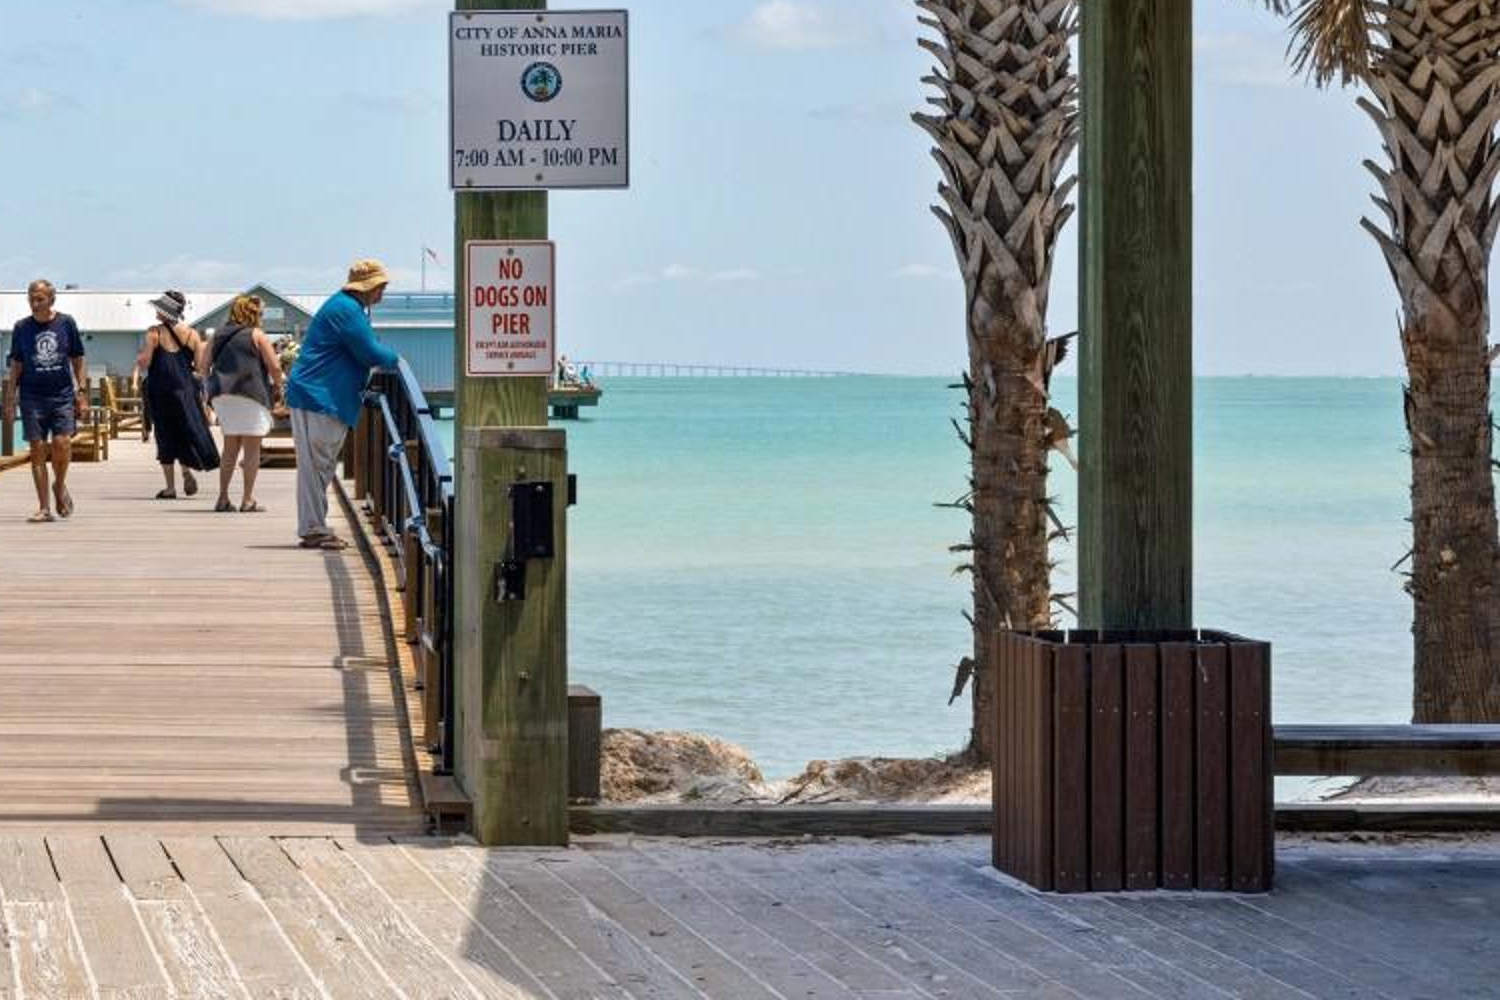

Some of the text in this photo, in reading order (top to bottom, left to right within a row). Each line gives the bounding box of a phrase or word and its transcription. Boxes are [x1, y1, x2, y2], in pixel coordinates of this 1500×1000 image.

[455, 26, 622, 40] CITY OF ANNA MARIA
[481, 43, 597, 56] HISTORIC PIER
[498, 120, 576, 142] DAILY
[456, 149, 489, 167] 7:00
[493, 149, 524, 166] AM
[543, 149, 583, 166] 10:00
[589, 148, 618, 166] PM
[499, 258, 523, 279] NO
[475, 286, 547, 307] DOGS ON
[492, 314, 530, 335] PIER
